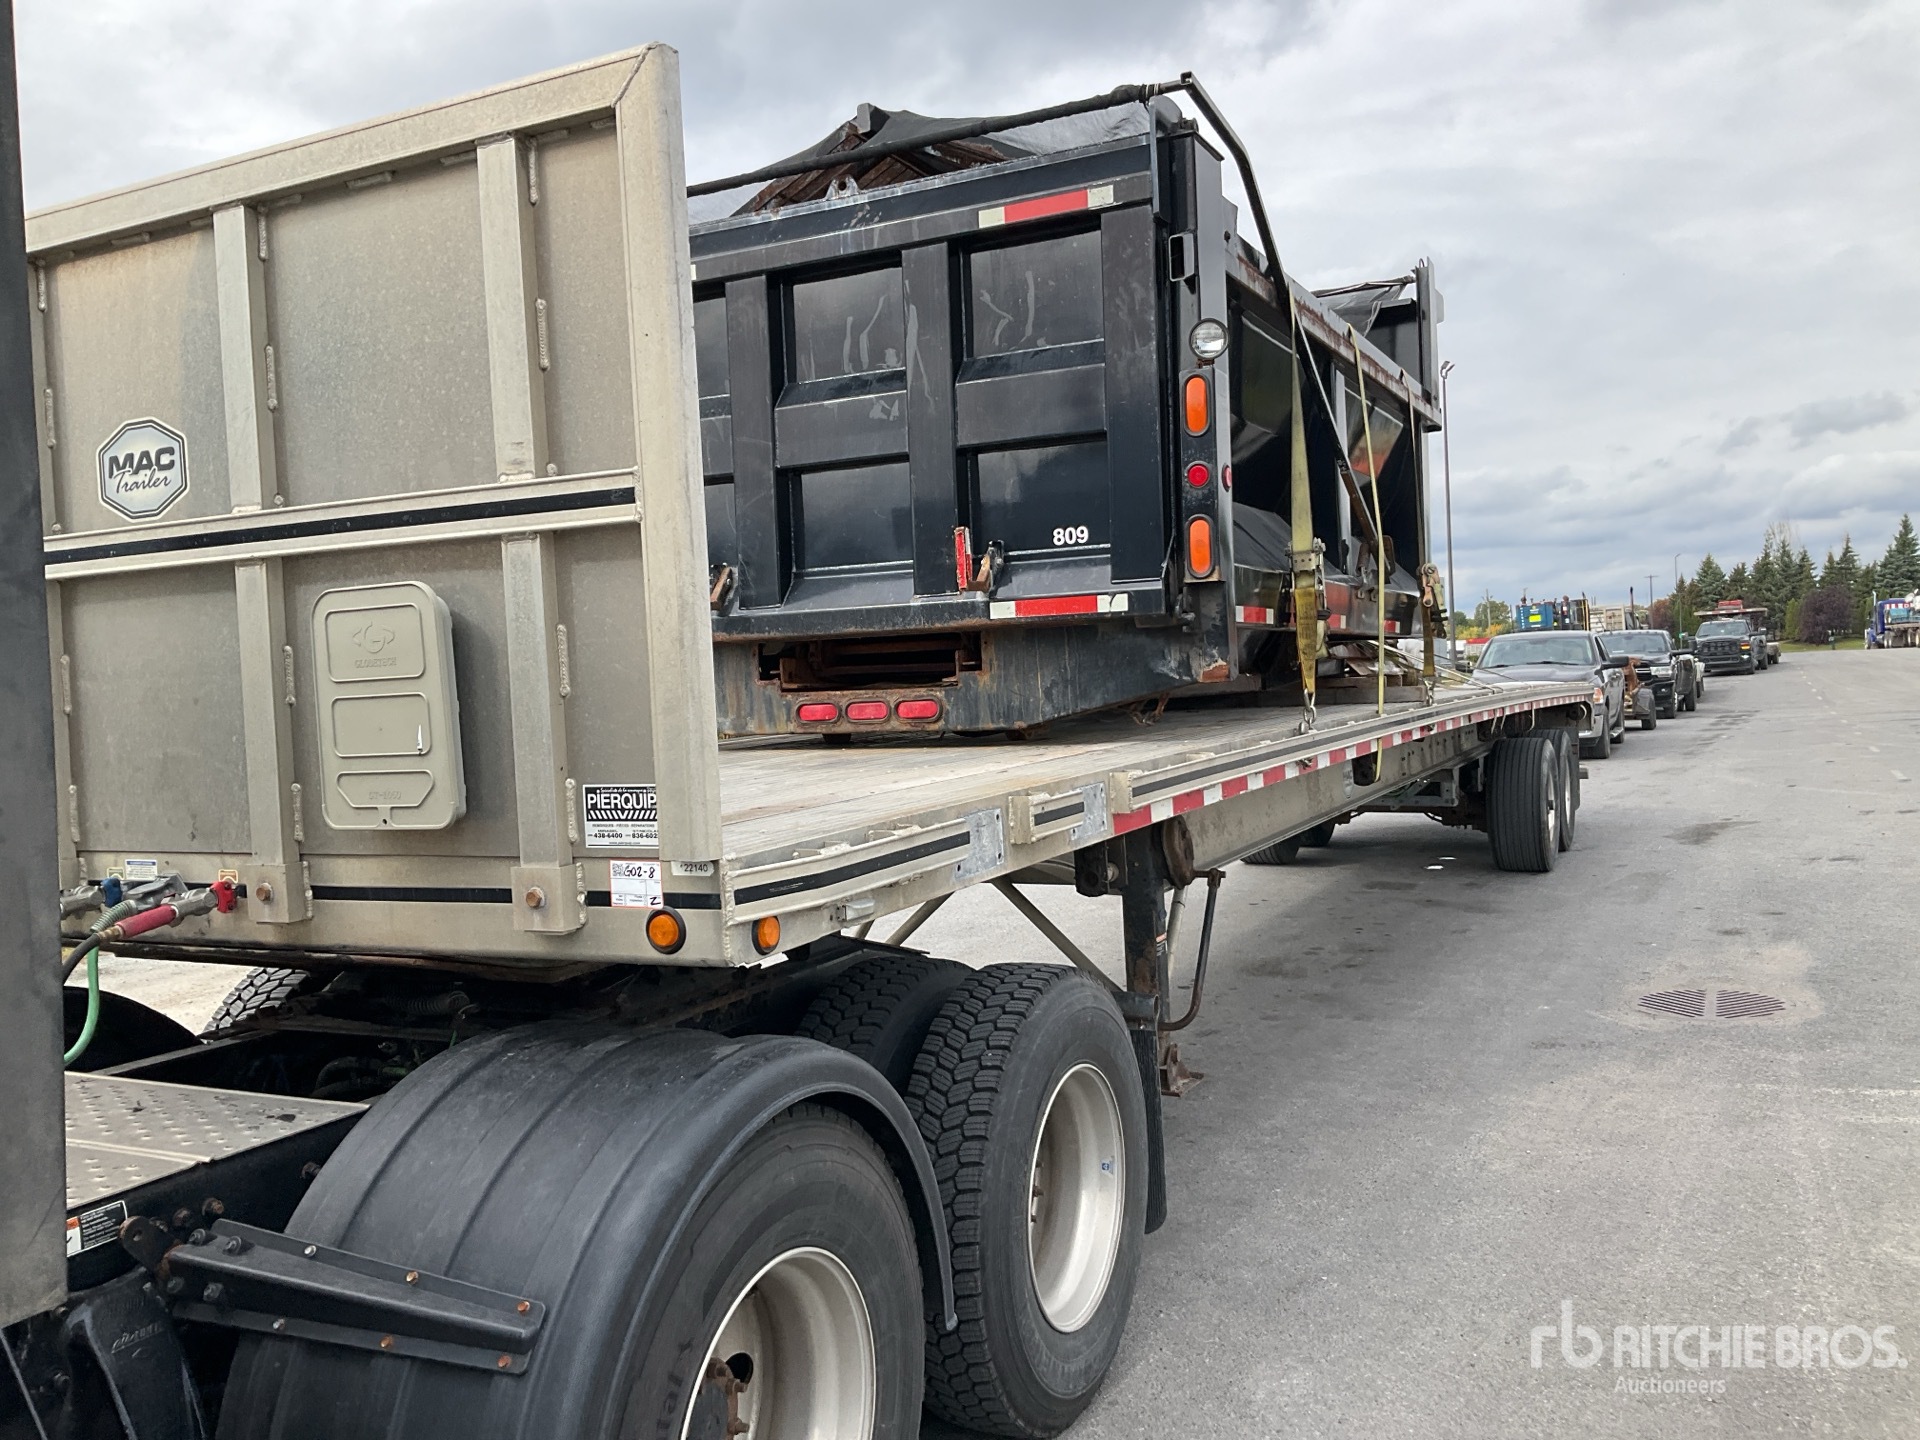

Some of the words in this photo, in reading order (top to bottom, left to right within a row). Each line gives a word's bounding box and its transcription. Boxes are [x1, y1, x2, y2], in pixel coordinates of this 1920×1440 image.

[108, 446, 175, 479] MAC
[113, 467, 171, 494] Trailer
[1053, 526, 1089, 546] 809
